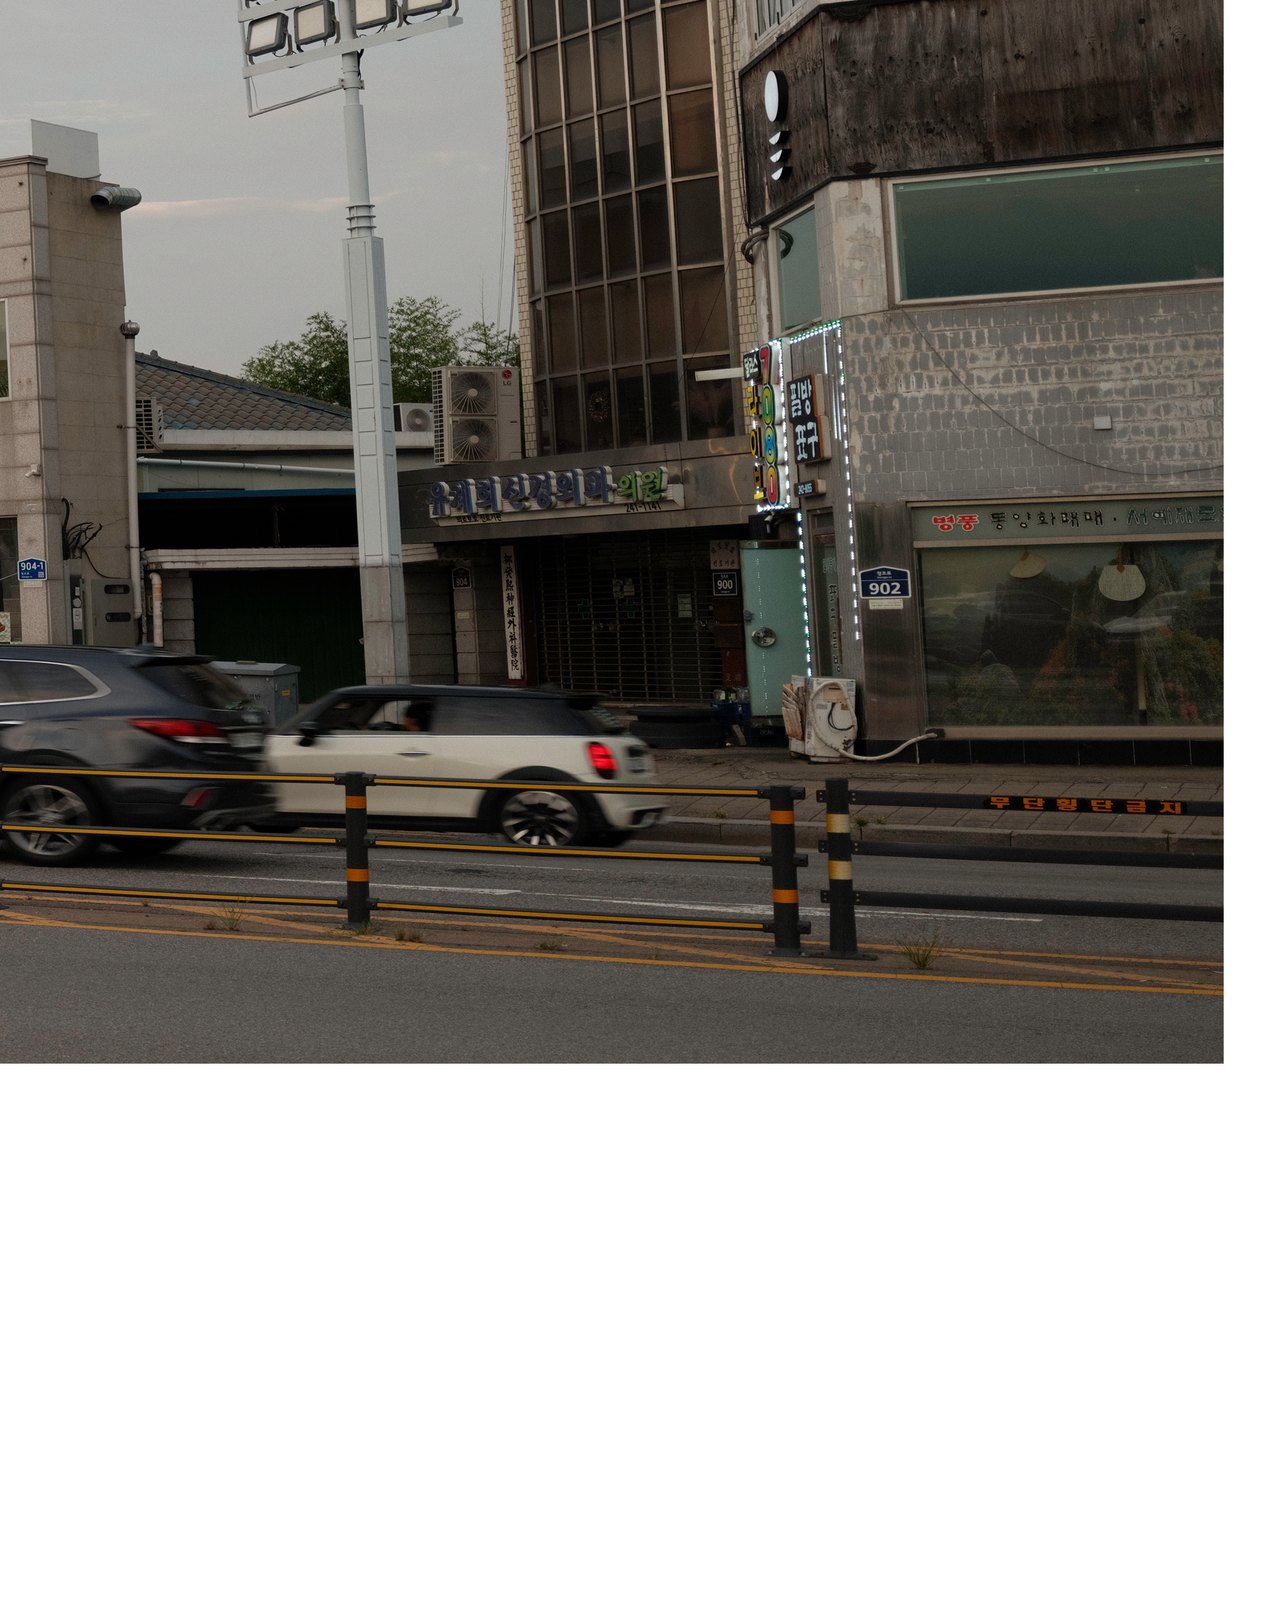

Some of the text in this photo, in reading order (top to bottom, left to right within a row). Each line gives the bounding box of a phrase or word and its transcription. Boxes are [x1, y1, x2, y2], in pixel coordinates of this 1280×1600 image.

[790, 378, 813, 418] 필방
[759, 344, 779, 506] 7080
[795, 420, 819, 461] 표구
[932, 512, 980, 532] 병풍
[20, 561, 44, 571] 904-1
[455, 577, 468, 587] 904
[716, 579, 734, 590] 900
[868, 582, 902, 595] 902
[989, 795, 1183, 815] 무단횡단금지
